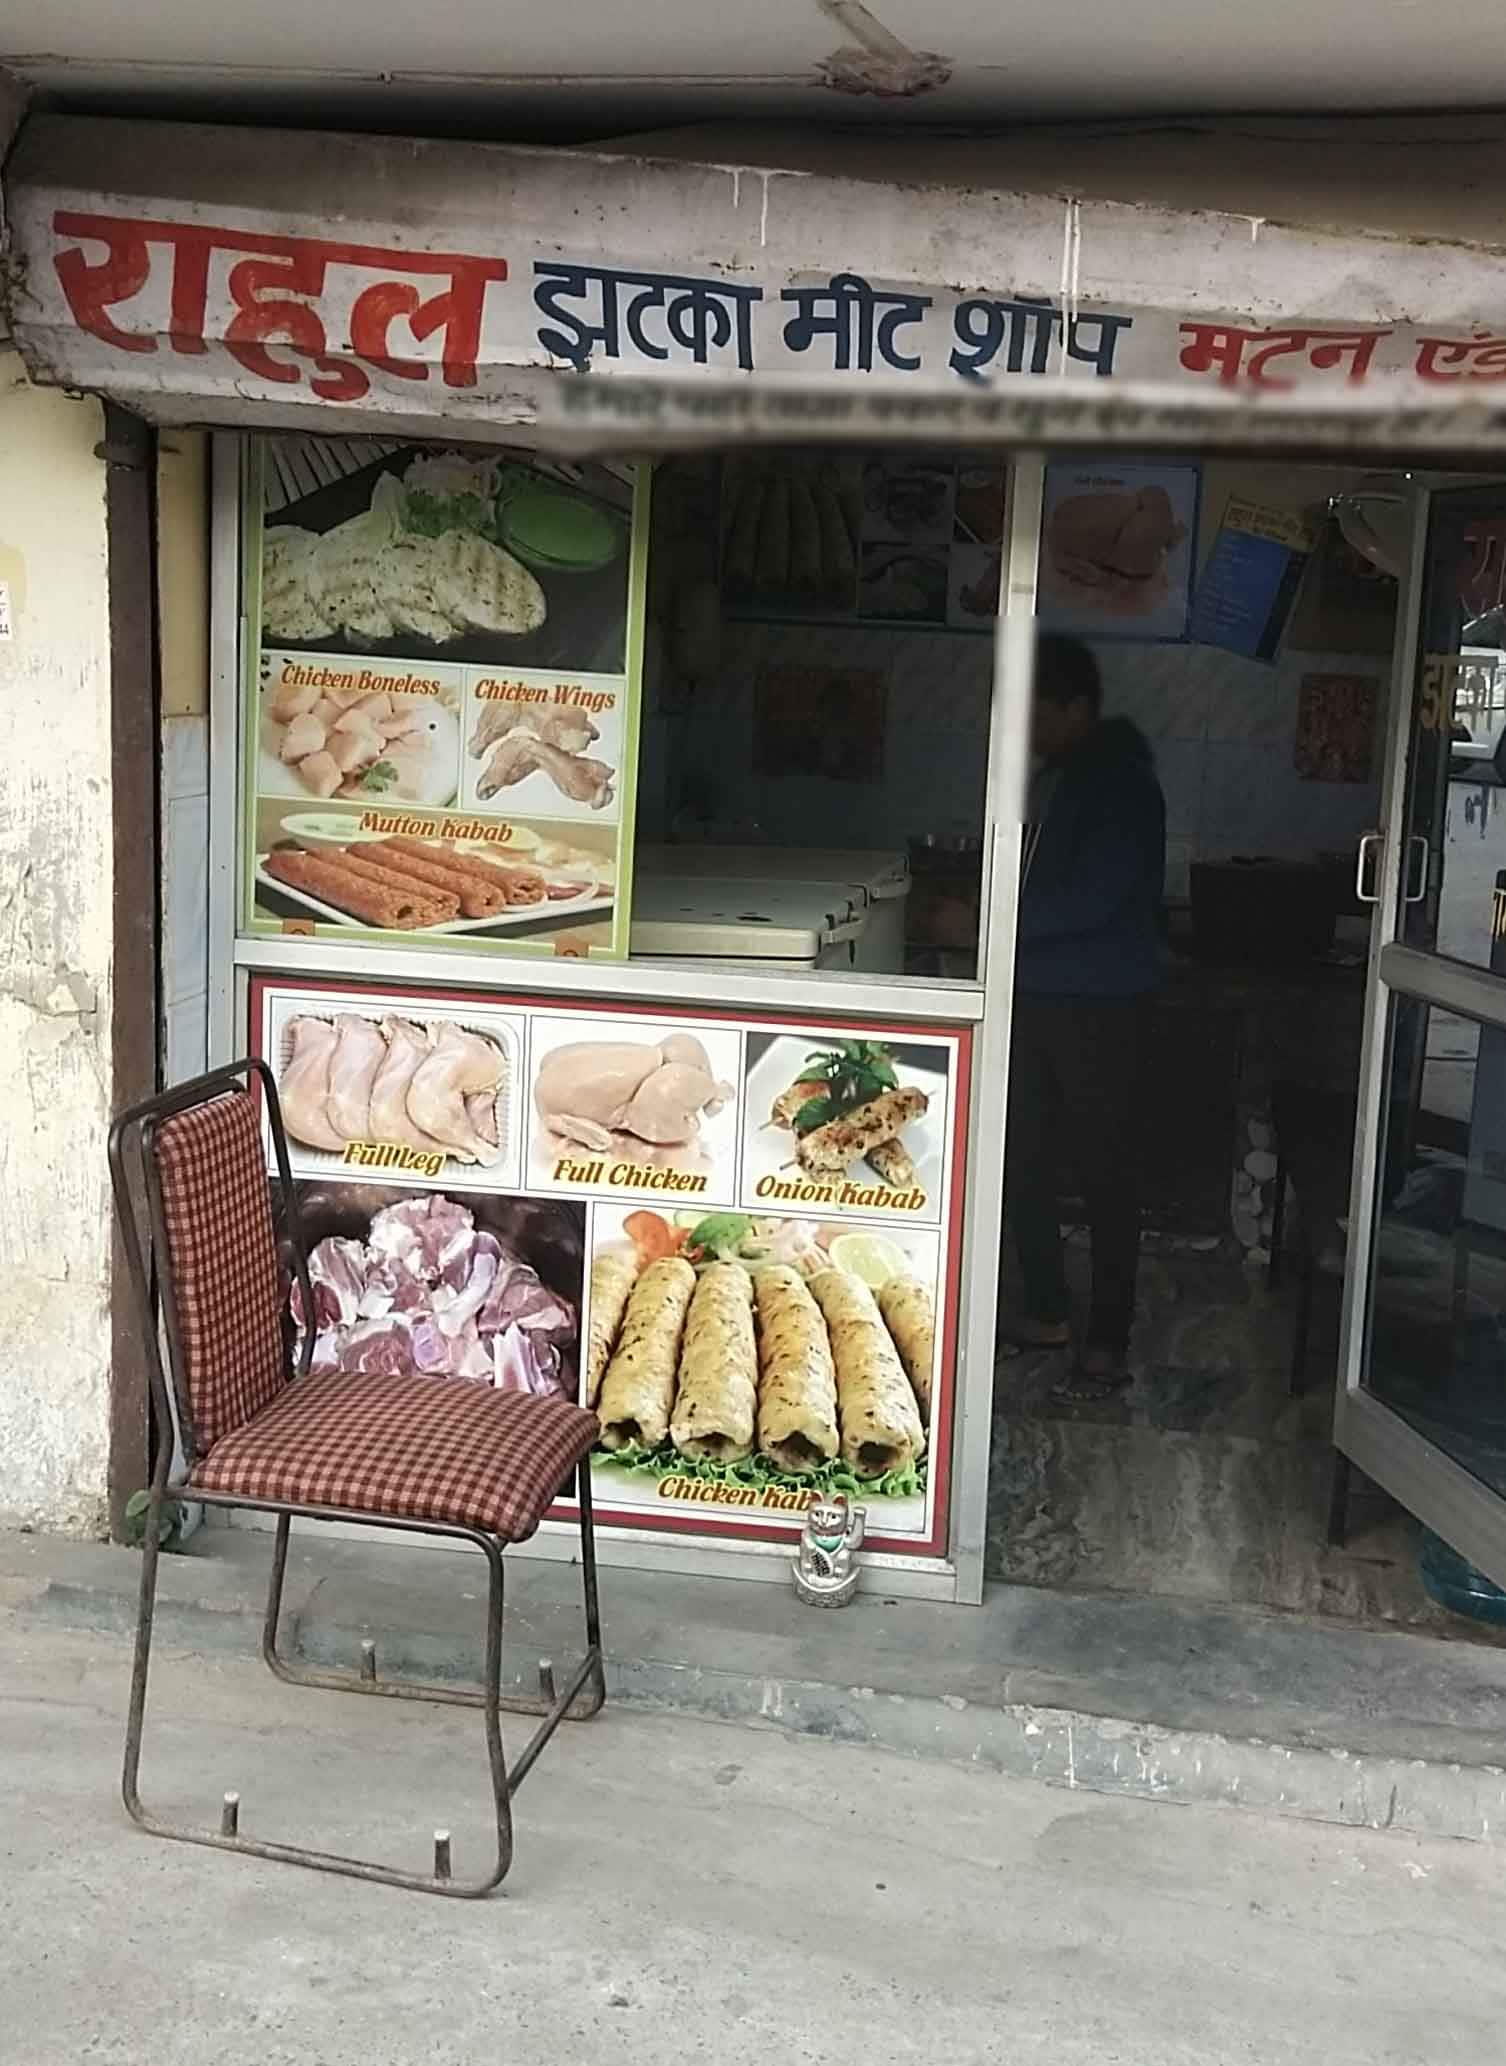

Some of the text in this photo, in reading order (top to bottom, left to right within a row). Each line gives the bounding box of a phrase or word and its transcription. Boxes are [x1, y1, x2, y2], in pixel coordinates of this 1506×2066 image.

[53, 210, 507, 401] राहुल
[533, 262, 763, 373] झटका
[781, 274, 932, 373] मीट
[1179, 322, 1393, 392] मटन
[281, 664, 440, 696] Chicken Boneless
[474, 679, 616, 711] Chicken Wings
[359, 812, 513, 842] Mutton Kabab
[344, 1143, 444, 1176] Full Leg
[553, 1160, 706, 1192] Full Chicken
[756, 1175, 927, 1211] Onion Kabab
[658, 1476, 756, 1506] Chicken
